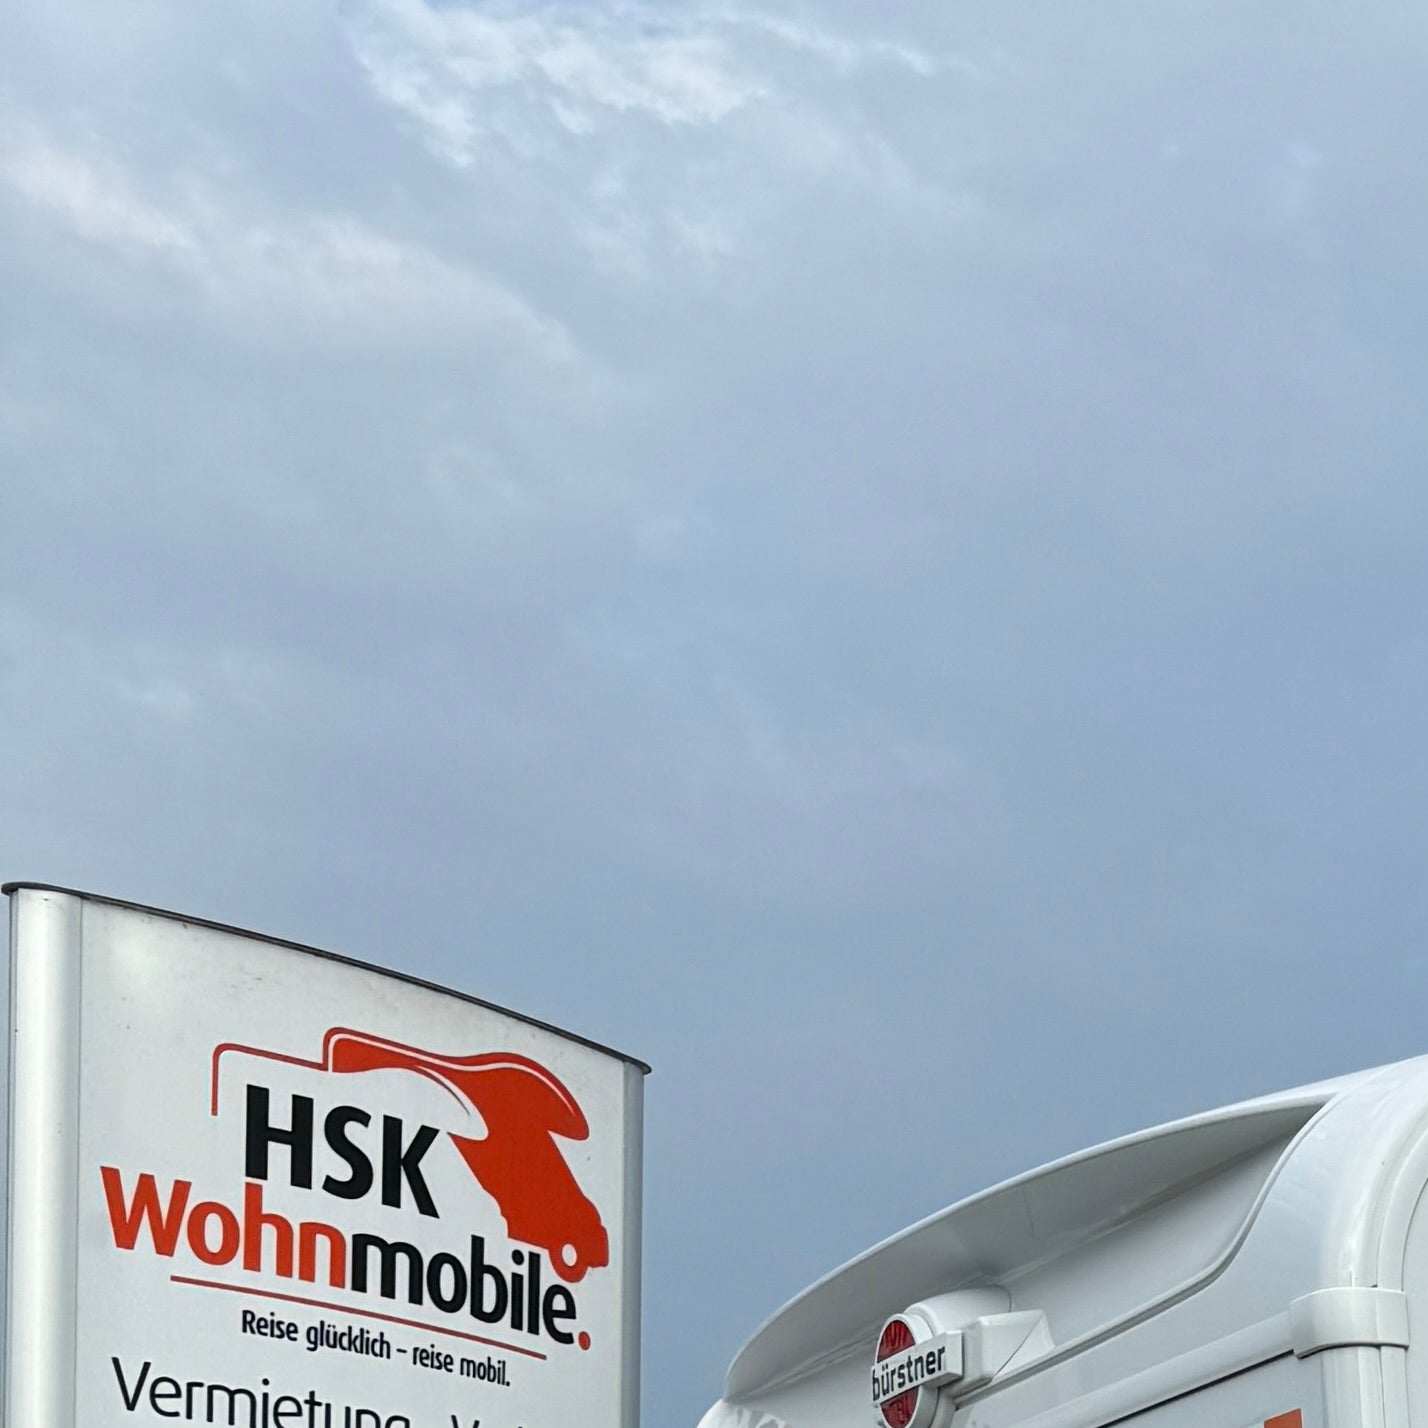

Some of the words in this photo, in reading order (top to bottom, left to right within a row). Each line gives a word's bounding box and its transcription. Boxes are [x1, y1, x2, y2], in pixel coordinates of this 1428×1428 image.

[245, 1083, 440, 1219] HSK
[100, 1166, 591, 1351] Wohnmobile.
[241, 1309, 299, 1342] Reise
[306, 1321, 391, 1360] glücklich
[412, 1343, 454, 1373] reise
[459, 1357, 511, 1387] mobil.
[872, 1346, 946, 1402] bürstner
